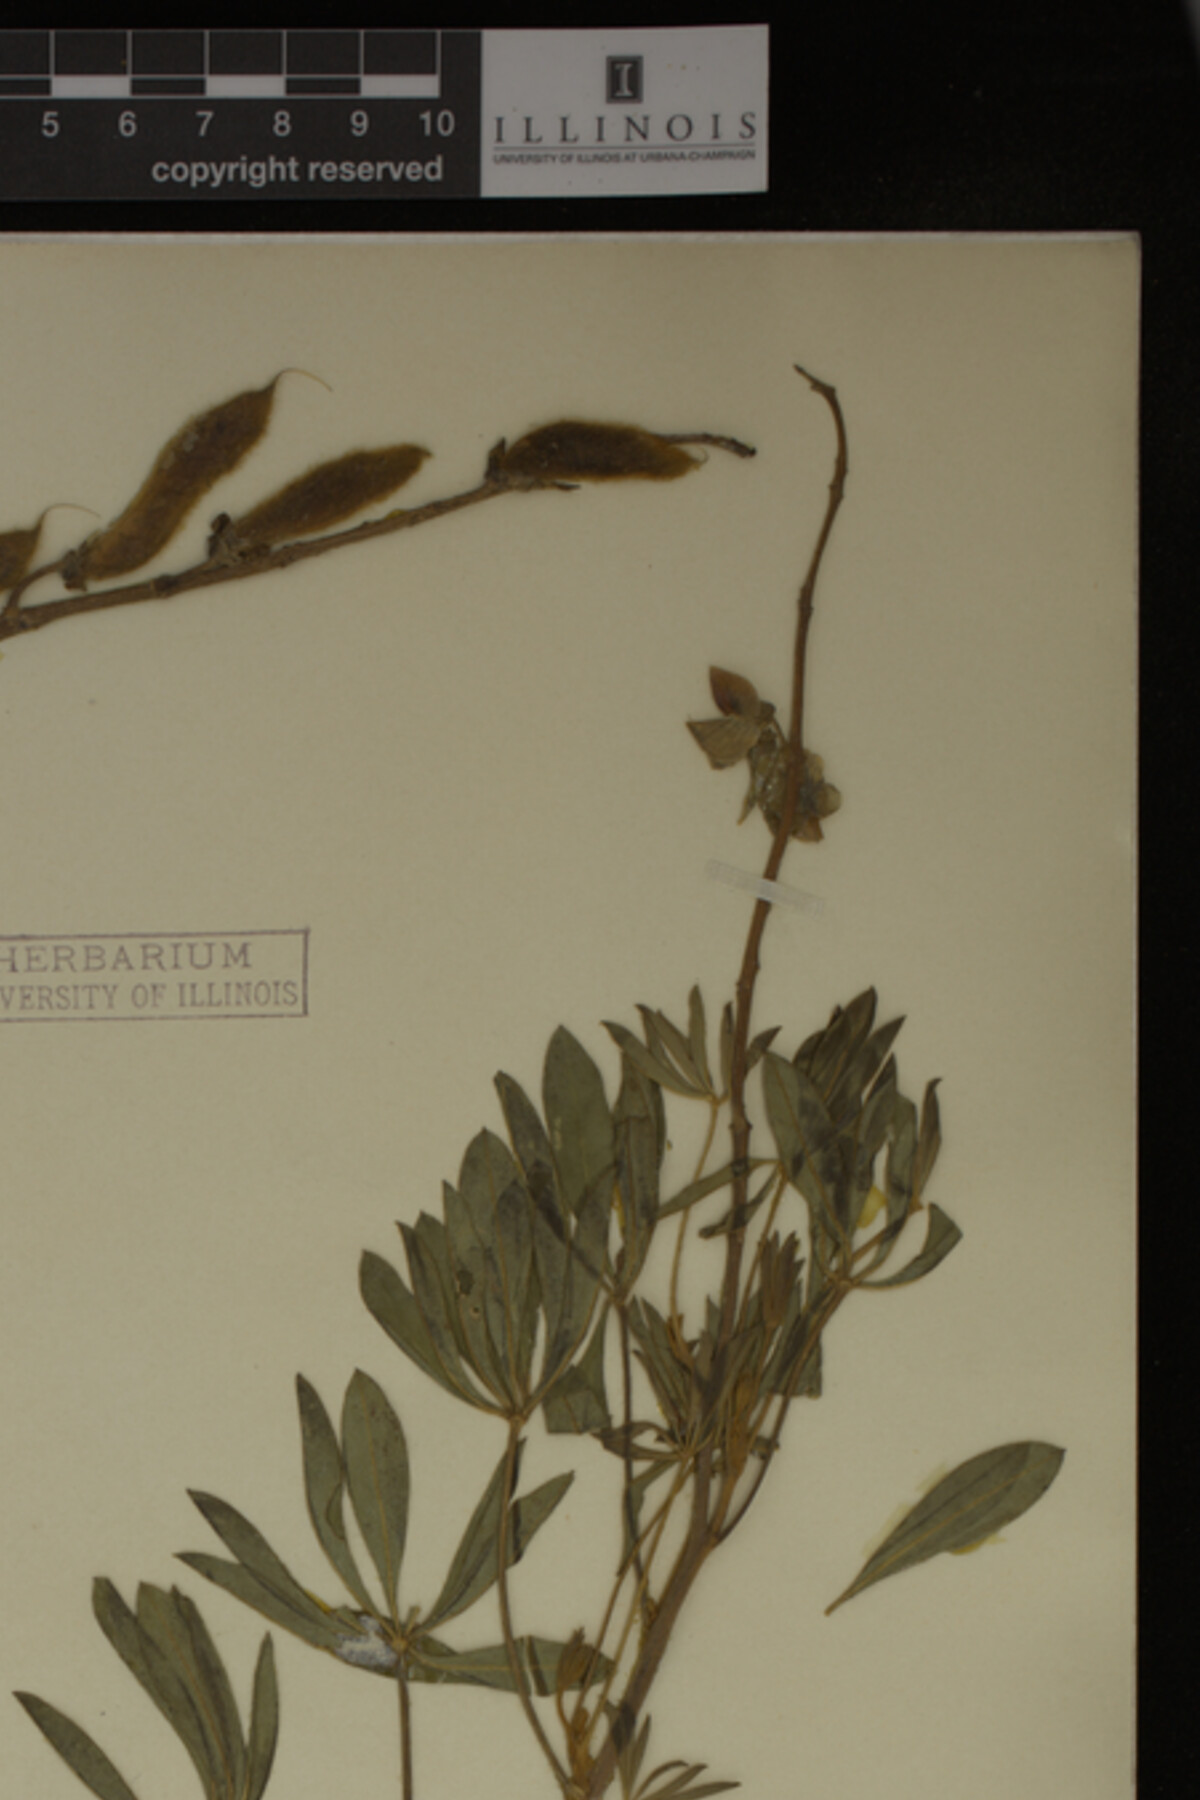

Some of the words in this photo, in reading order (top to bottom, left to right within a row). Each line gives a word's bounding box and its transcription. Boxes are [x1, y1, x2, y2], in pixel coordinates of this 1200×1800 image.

[42, 110, 60, 138] 5
[118, 110, 137, 137] 6
[196, 110, 214, 137] 7
[272, 110, 292, 137] 8
[350, 110, 369, 137] 9
[419, 109, 455, 137] 10
[495, 112, 756, 143] ILLINOIS
[151, 155, 299, 188] copyright
[308, 154, 443, 182] reserved
[493, 152, 558, 164] UNIVERSITY
[560, 151, 574, 163] OF
[577, 151, 621, 163] ILLINOIS
[623, 151, 637, 162] AT
[131, 983, 167, 1009] OF
[178, 980, 299, 1008] ILLINOIS
